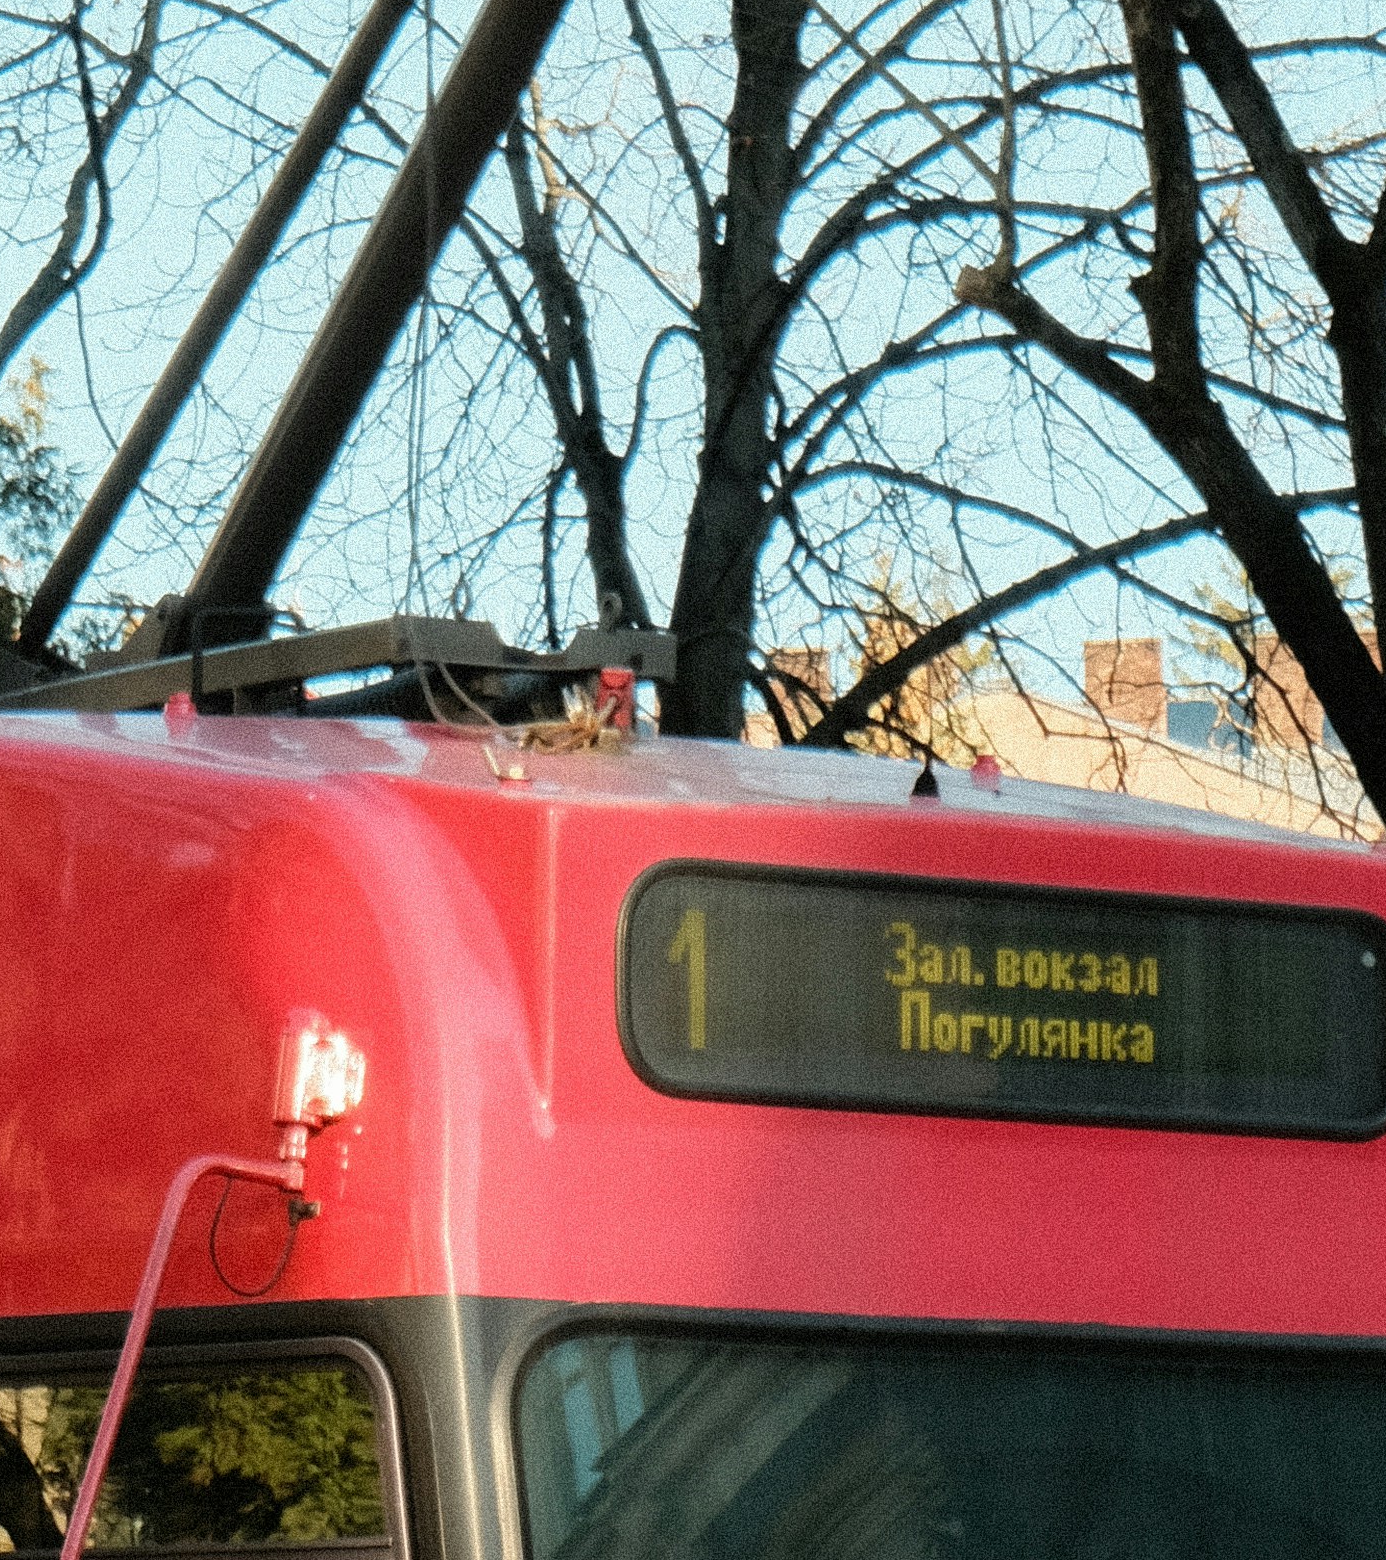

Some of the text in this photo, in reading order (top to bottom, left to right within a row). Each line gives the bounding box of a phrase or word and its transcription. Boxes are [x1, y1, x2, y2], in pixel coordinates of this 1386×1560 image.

[666, 908, 707, 1051] 1
[884, 921, 1159, 997] Зал. вокзал
[900, 990, 1155, 1063] Погулянка
